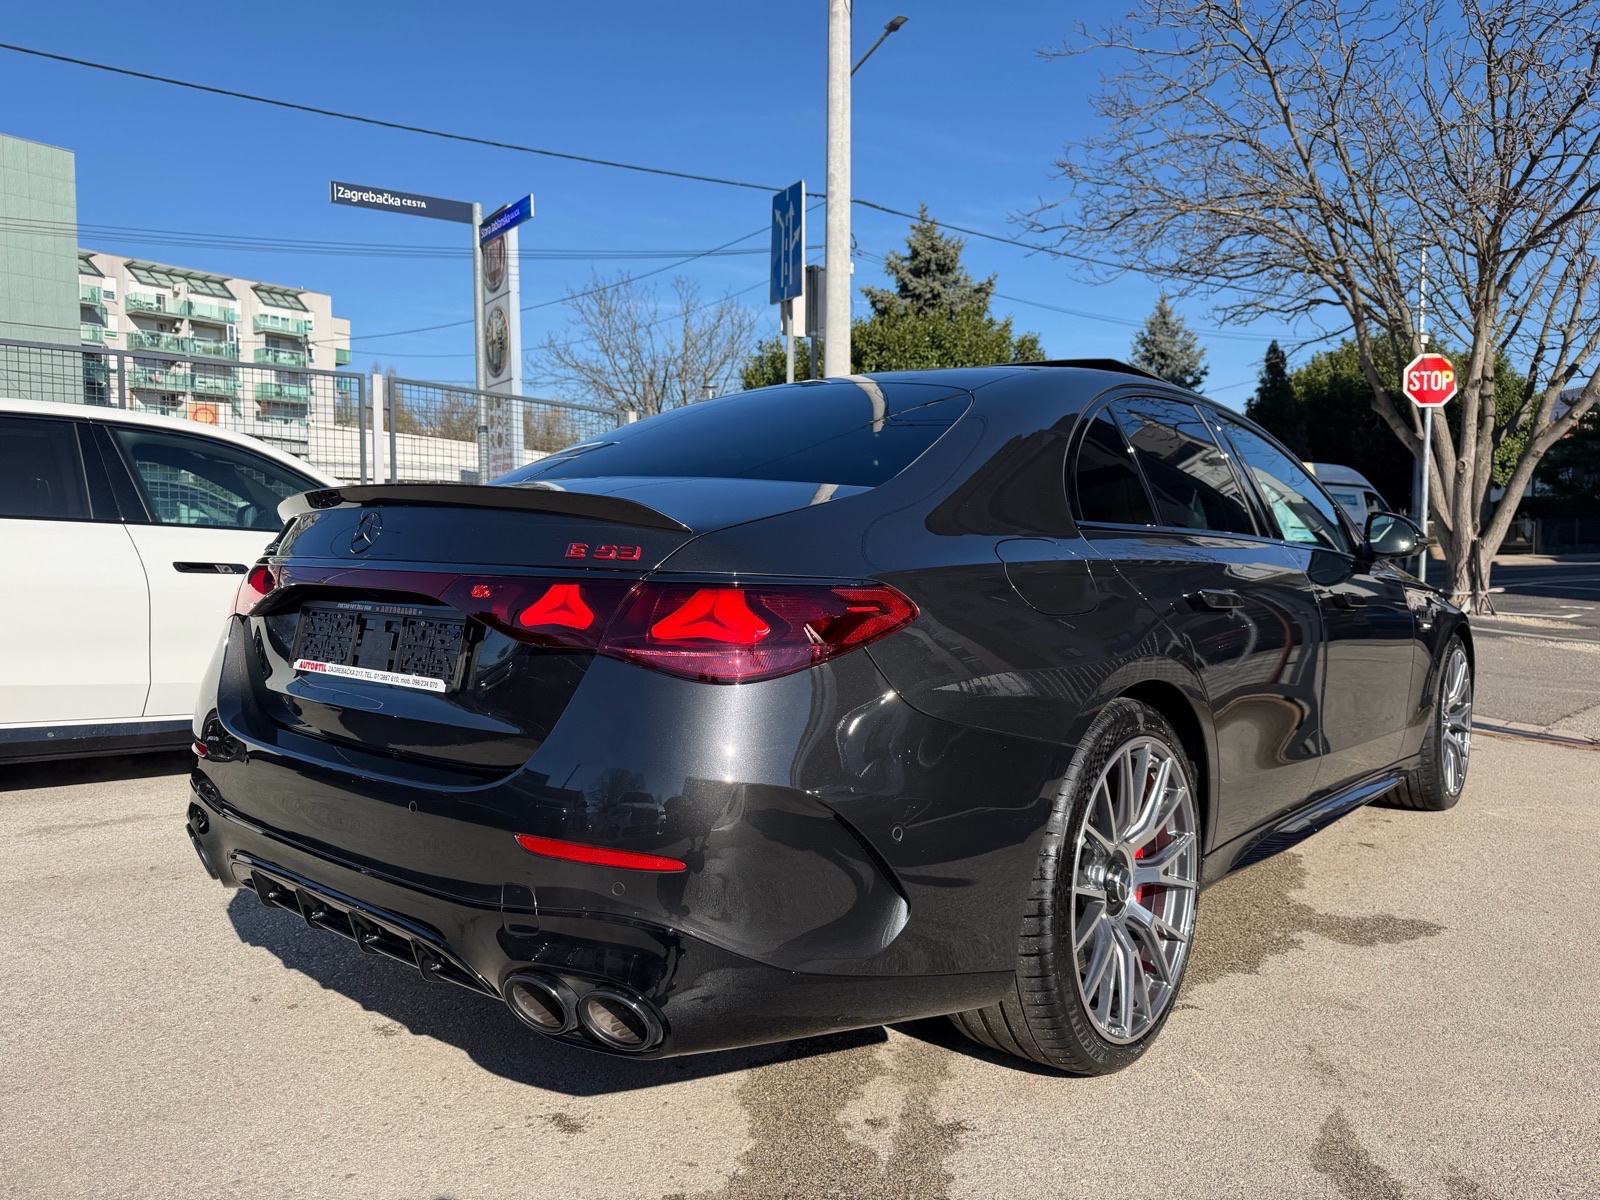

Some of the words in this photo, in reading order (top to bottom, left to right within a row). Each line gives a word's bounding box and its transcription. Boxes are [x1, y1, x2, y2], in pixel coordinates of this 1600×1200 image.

[337, 186, 401, 207] Zagrebačka
[401, 198, 427, 209] CESTA
[1409, 370, 1455, 391] STOP
[564, 543, 589, 560] E
[592, 544, 641, 561] 53
[299, 660, 327, 673] AUTOSTIL
